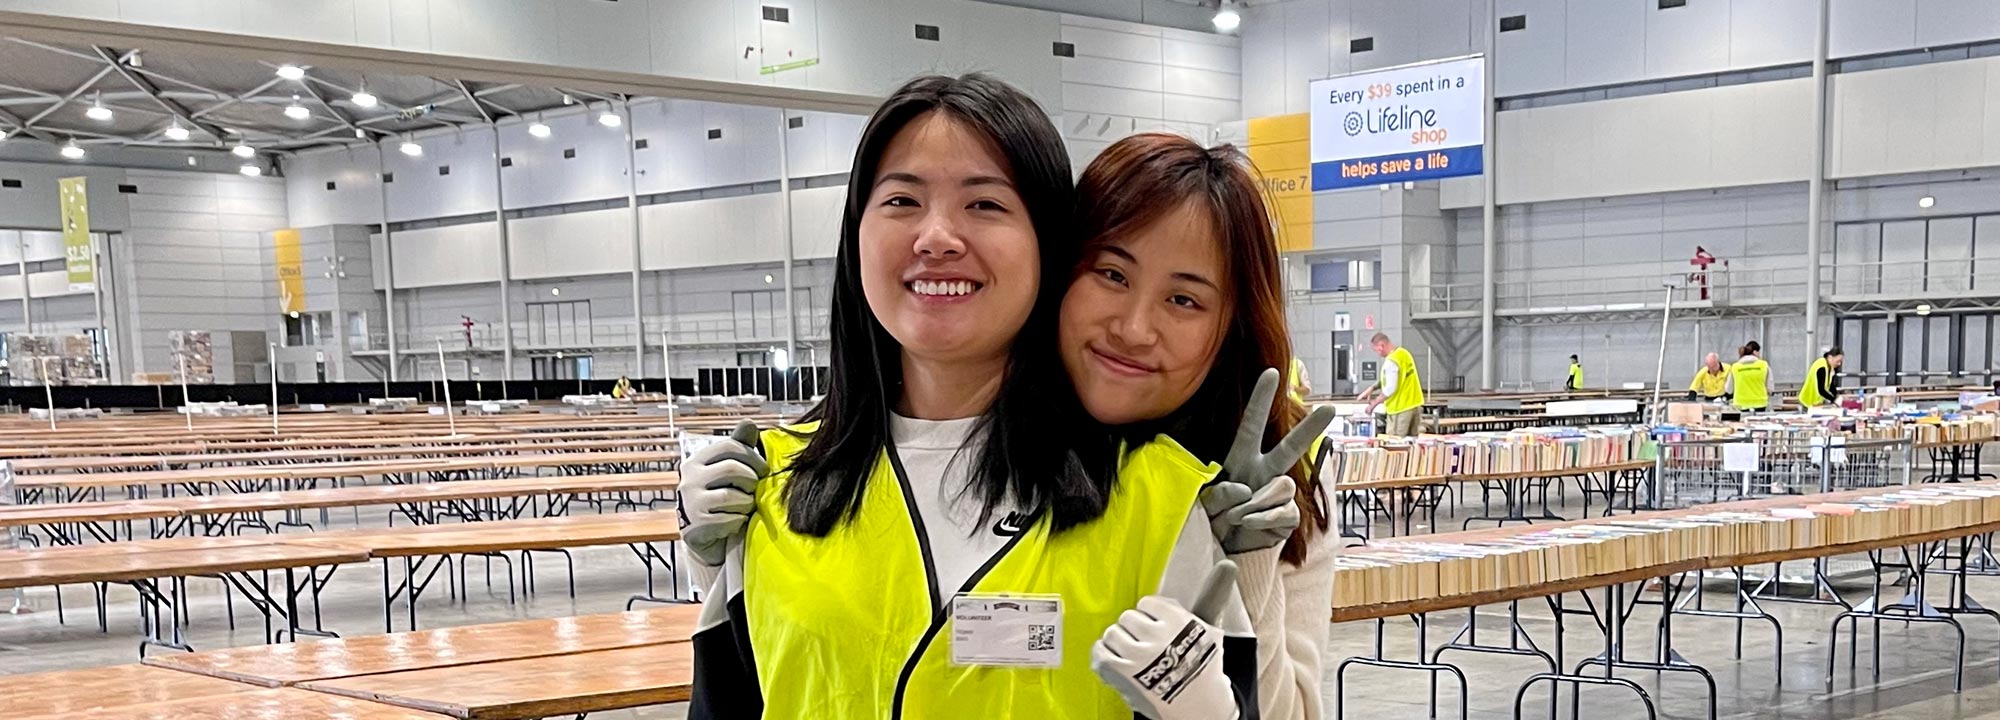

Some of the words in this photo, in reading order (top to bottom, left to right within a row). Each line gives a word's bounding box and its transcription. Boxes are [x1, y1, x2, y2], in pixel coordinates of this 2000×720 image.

[1330, 89, 1364, 104] Every
[1367, 83, 1392, 100] $39
[1396, 77, 1434, 97] spent
[1438, 75, 1450, 90] in
[1456, 77, 1464, 88] a
[1367, 104, 1437, 134] Lifeline
[1411, 127, 1448, 145] shop
[1341, 161, 1378, 178] helps
[1380, 158, 1412, 174] save
[1414, 157, 1424, 170] a
[1427, 152, 1448, 169] life
[1300, 175, 1307, 190] 7
